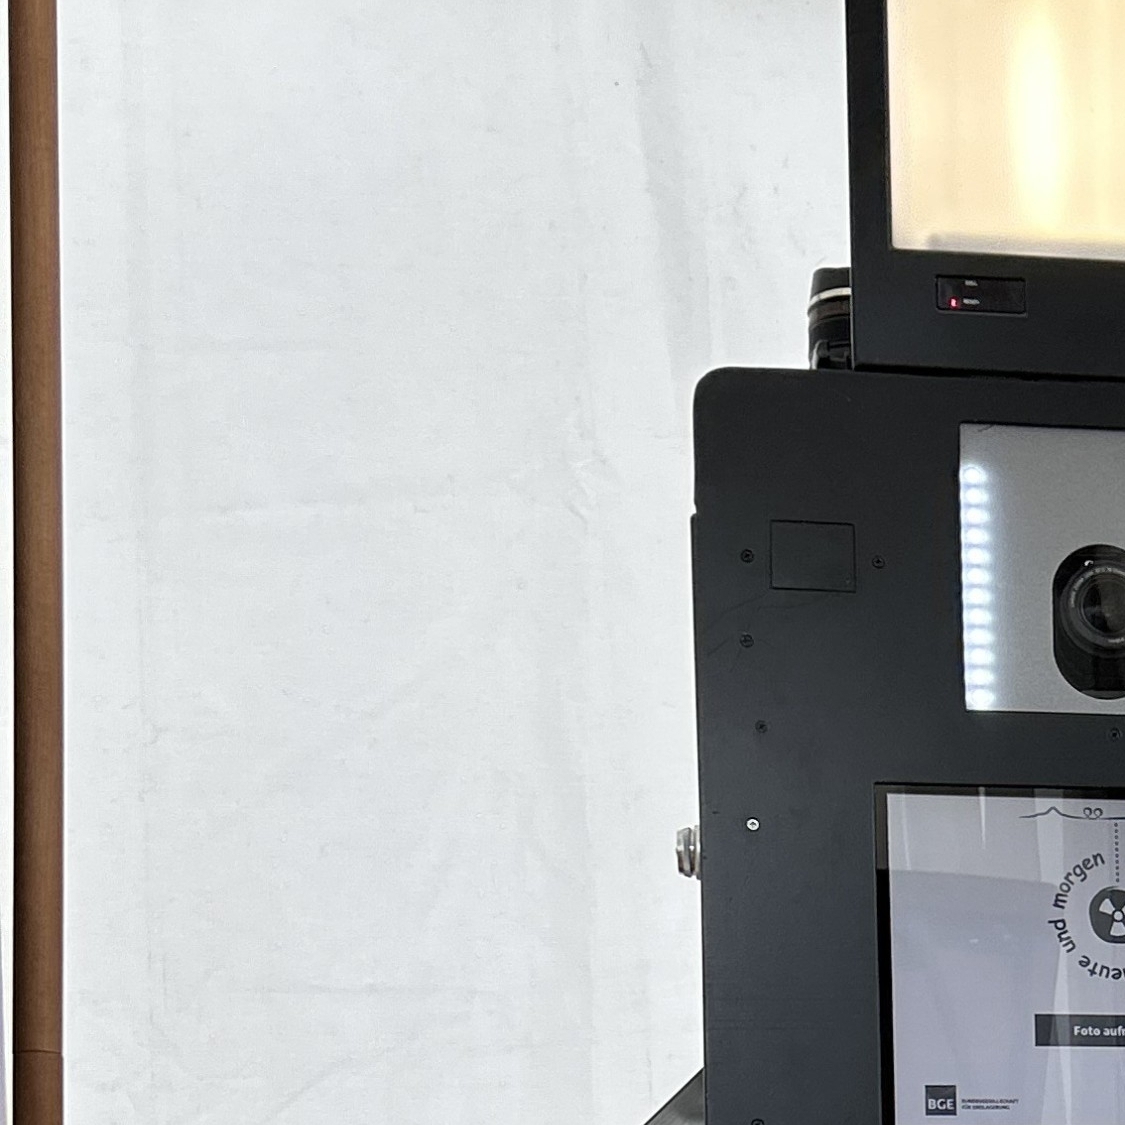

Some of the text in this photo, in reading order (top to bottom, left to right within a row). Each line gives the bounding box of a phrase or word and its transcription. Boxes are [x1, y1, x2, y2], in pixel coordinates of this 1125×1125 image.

[1052, 852, 1106, 909] morgen
[1048, 918, 1076, 953] und
[1073, 1025, 1101, 1036] Foto
[927, 1098, 955, 1110] BGE
